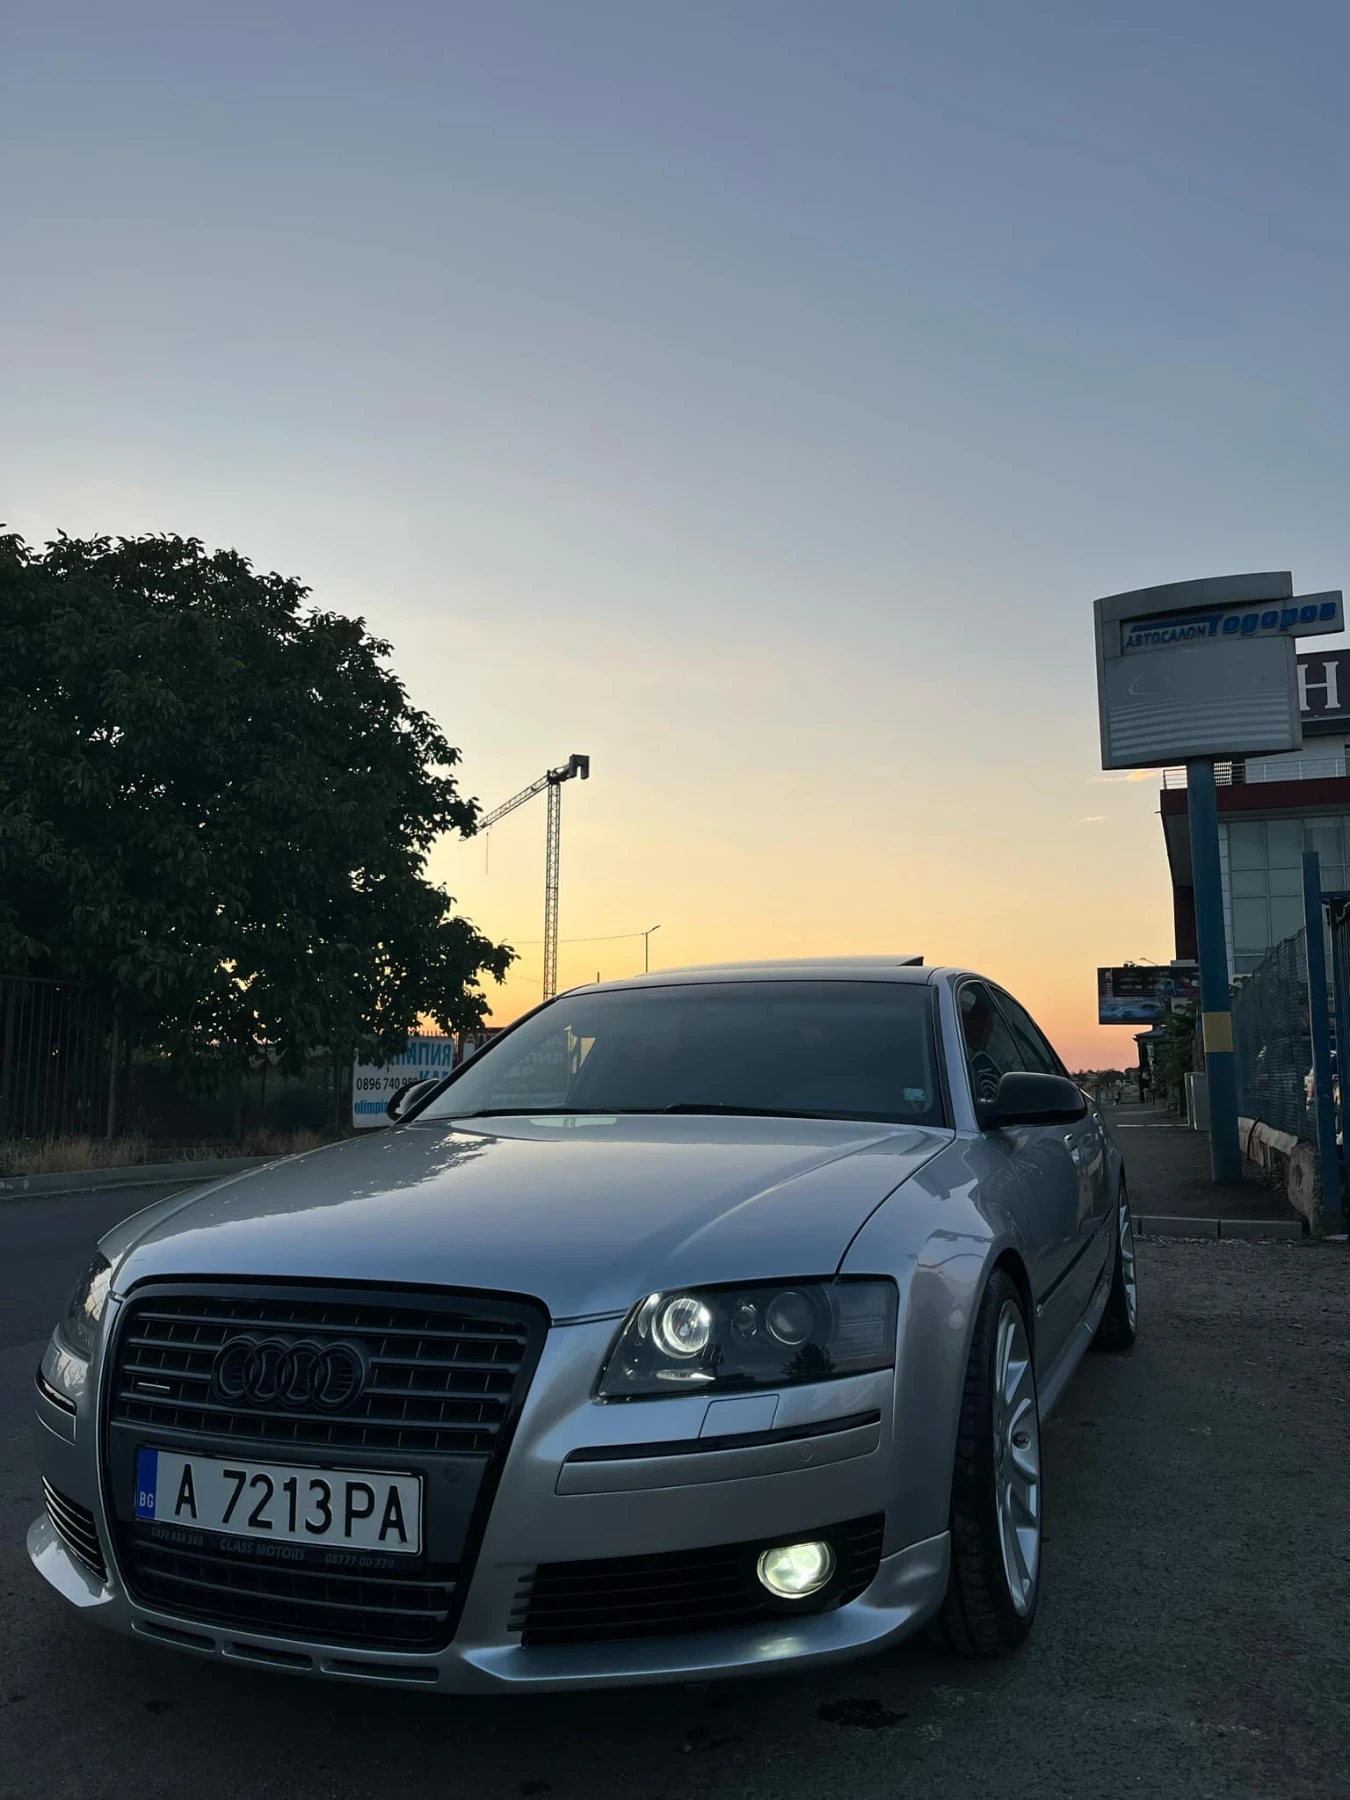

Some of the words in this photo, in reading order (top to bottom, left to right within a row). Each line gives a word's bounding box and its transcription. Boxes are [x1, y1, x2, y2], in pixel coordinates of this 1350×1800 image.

[1125, 624, 1207, 648] АВТОСАЛОН
[356, 1077, 381, 1091] 0896
[383, 1077, 400, 1091] 740
[139, 1491, 154, 1509] BG
[174, 1463, 198, 1519] A
[219, 1538, 254, 1554] CLASS
[256, 1543, 304, 1561] MOTORS
